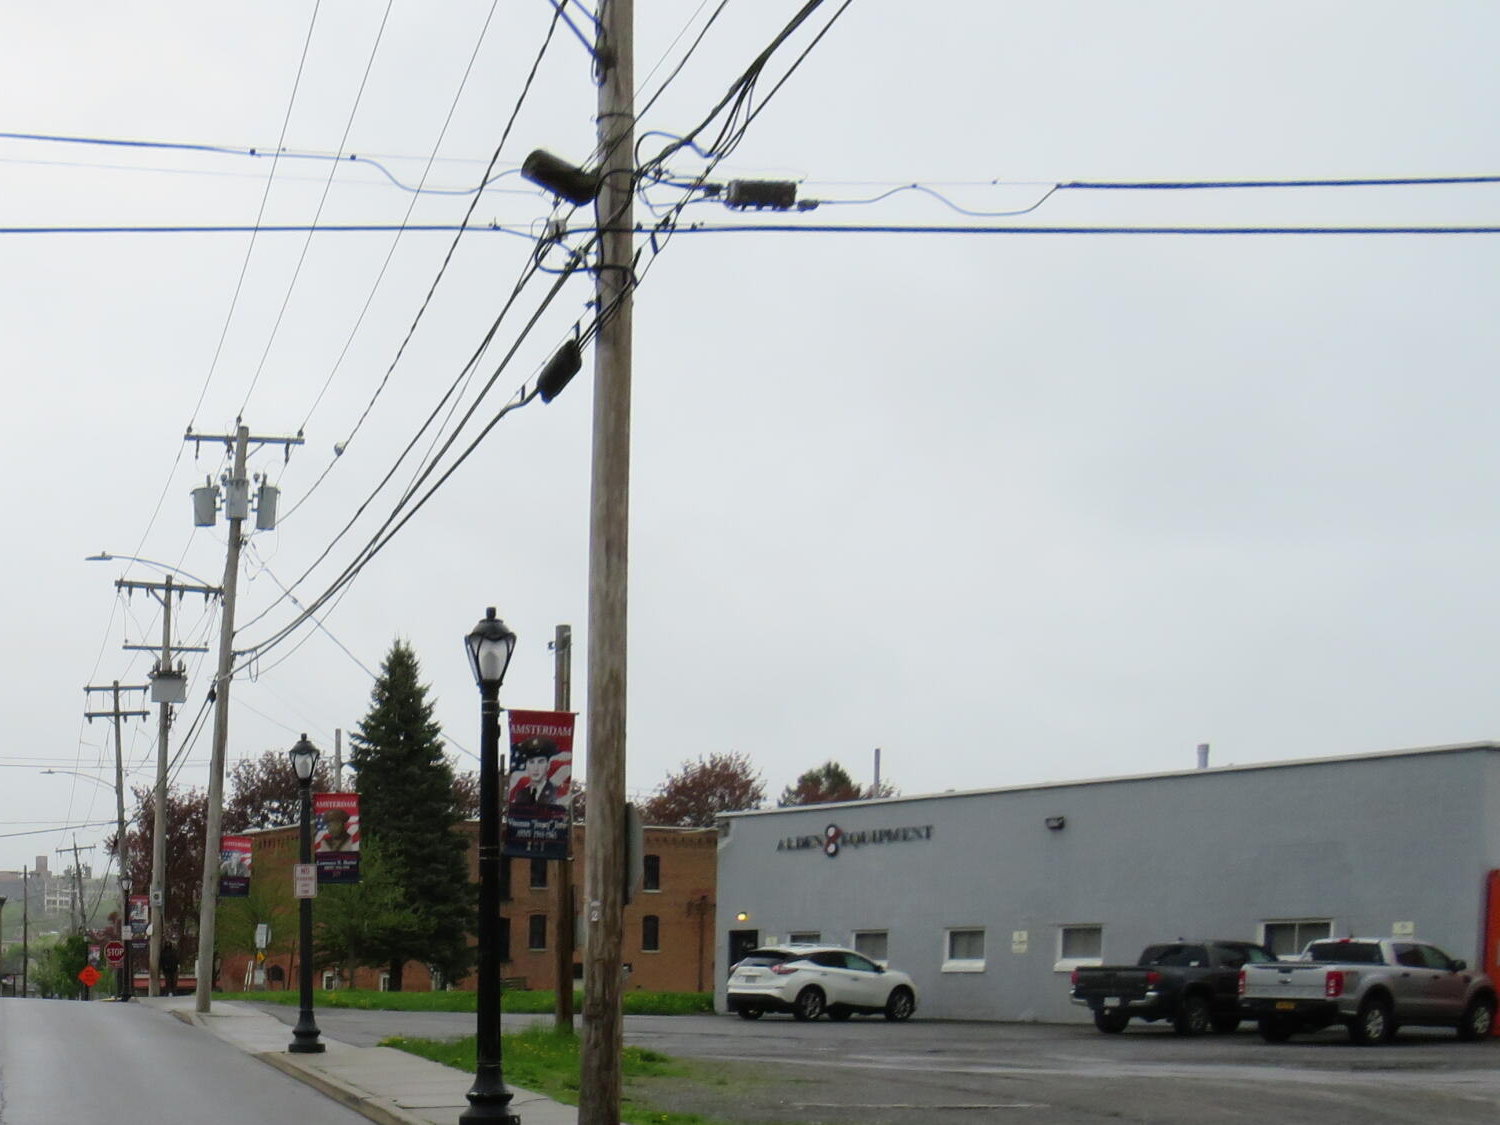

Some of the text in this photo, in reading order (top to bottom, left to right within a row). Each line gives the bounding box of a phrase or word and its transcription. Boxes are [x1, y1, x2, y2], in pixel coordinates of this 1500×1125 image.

[510, 723, 572, 737] AMSTERDAM
[315, 800, 357, 808] AMSTERDAM
[776, 824, 933, 852] ALDEN EQUIPMENT
[106, 947, 124, 956] STOP
